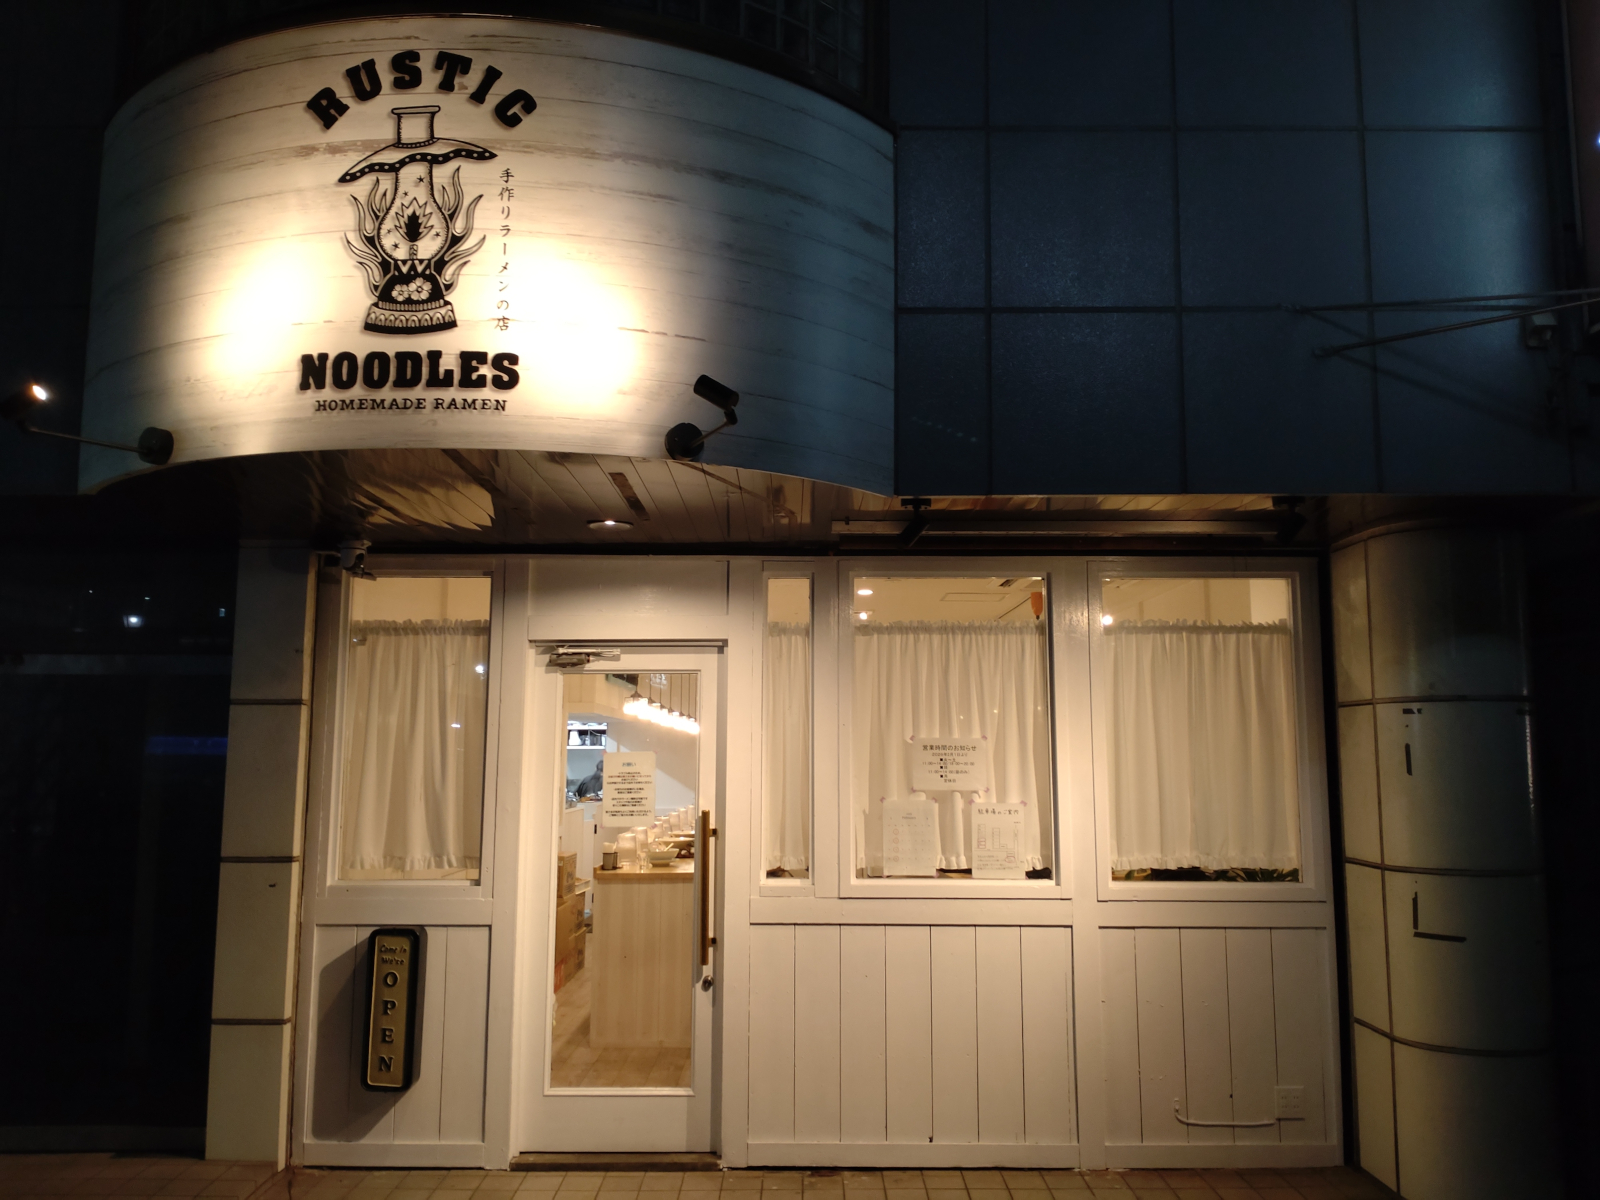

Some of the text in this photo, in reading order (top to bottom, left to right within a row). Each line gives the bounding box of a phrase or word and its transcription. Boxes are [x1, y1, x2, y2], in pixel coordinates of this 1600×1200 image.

[306, 50, 538, 130] RUSTIC
[494, 167, 515, 331] 手作りラーメンの店
[299, 350, 520, 391] NOODLES
[315, 398, 508, 412] HOMEMADE RAMEN
[922, 744, 977, 752] 営業時間のお知らせ
[378, 970, 399, 1072] OPEN
